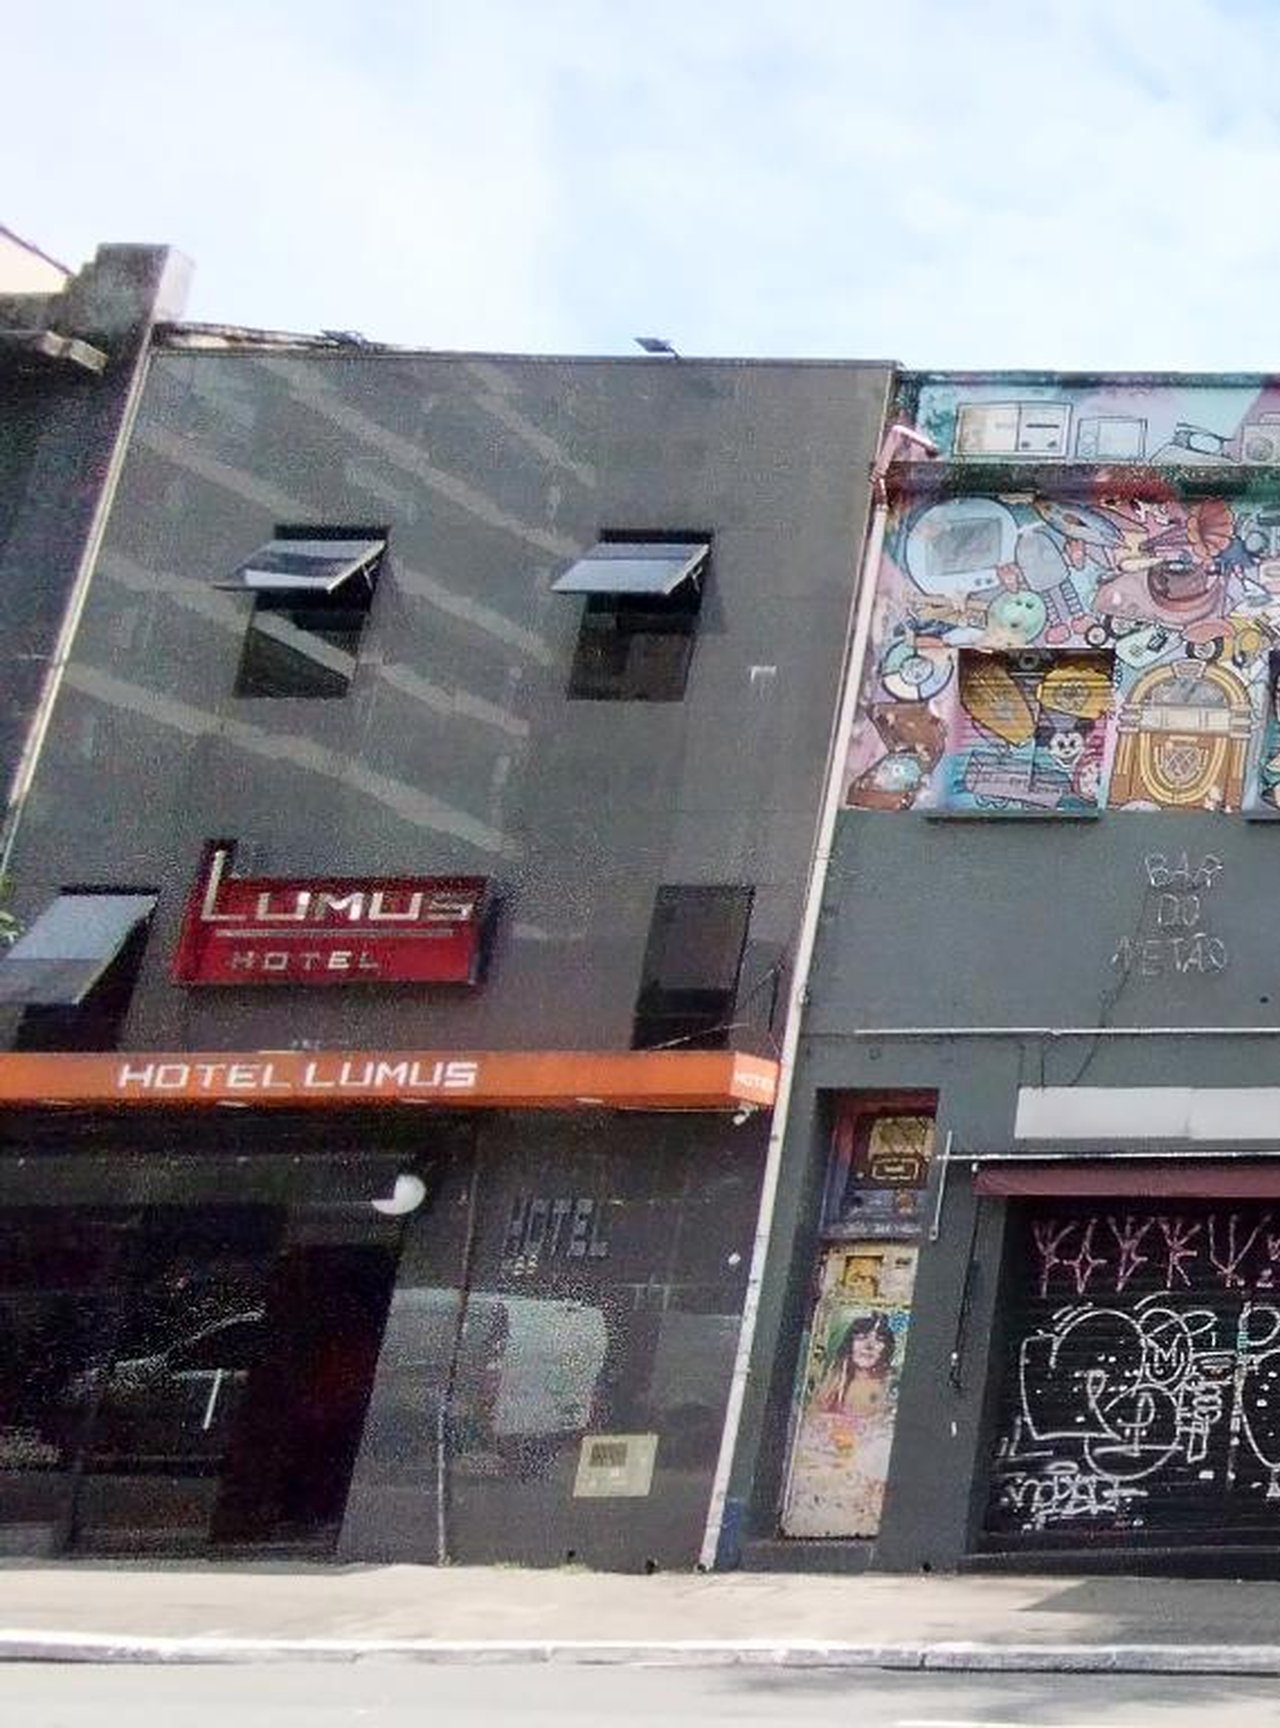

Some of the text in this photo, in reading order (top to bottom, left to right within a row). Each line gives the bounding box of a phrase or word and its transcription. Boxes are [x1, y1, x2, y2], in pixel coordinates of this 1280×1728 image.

[230, 951, 378, 971] HOTEL
[117, 1061, 478, 1089] HOTEL LUMUS
